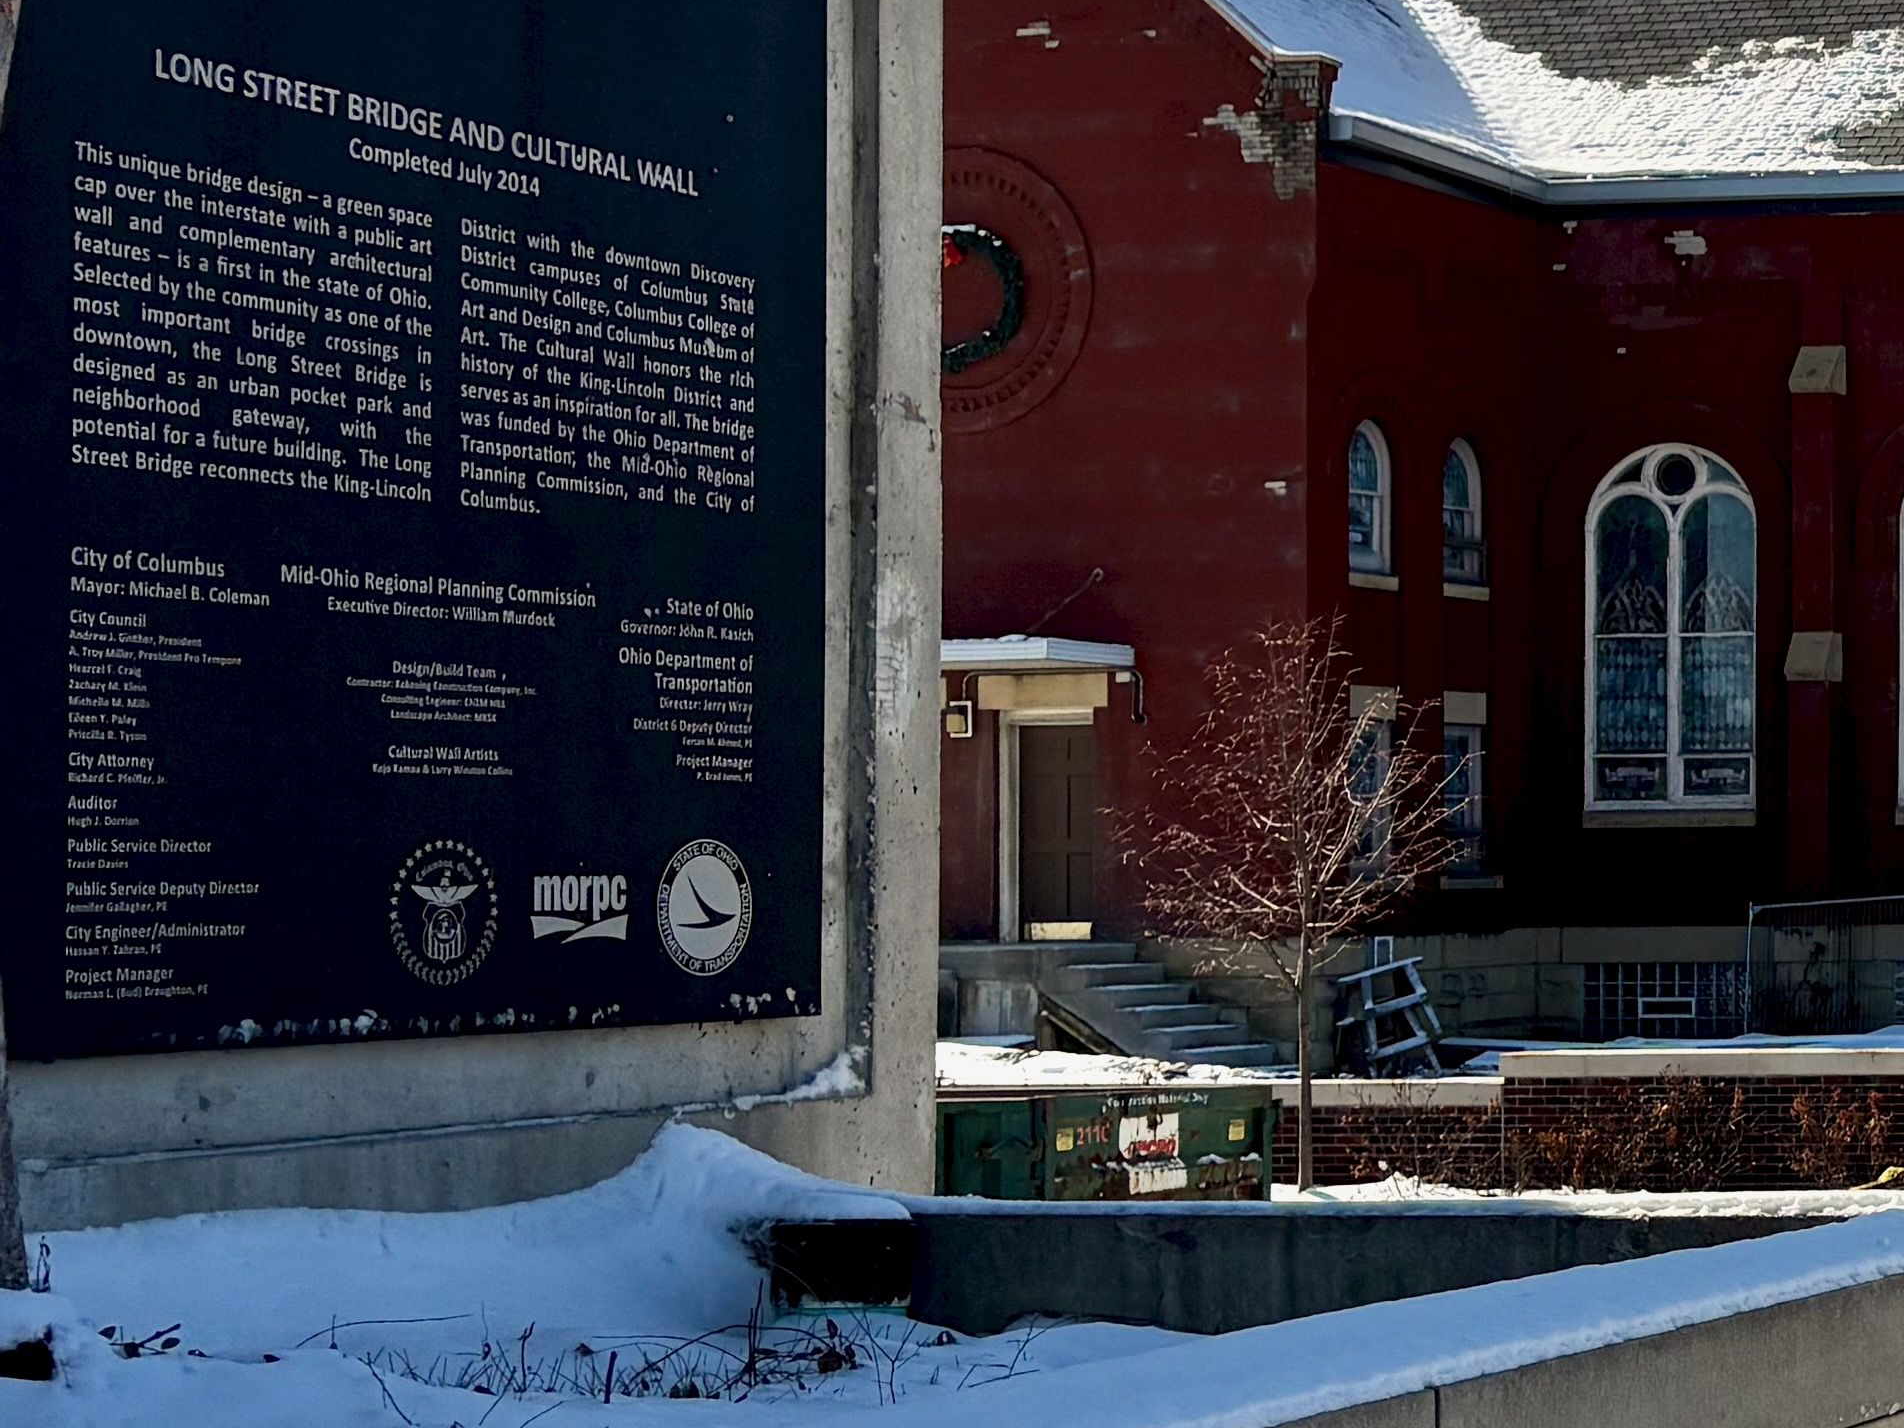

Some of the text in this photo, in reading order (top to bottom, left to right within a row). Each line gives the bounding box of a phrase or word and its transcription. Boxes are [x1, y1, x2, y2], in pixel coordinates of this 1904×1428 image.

[155, 48, 698, 196] LONG STREET BRIDGE AND CULTURAL WALL
[348, 137, 540, 197] Completed July 2014
[73, 205, 432, 282] wall and complementary architectural
[74, 175, 432, 255] cap over the interstate with a public art
[461, 217, 755, 294] District with the downtown Discovery
[73, 262, 432, 337] Selected by the community as one of the
[460, 272, 754, 339] Community College, Columbus College of
[73, 296, 431, 364] most important bridge crossings in
[73, 322, 432, 392] downtown, the Long Street Bridge is
[460, 326, 754, 389] Art. The Cultural Wall honors the rich
[72, 352, 431, 419] designed as an urban pocket park and
[460, 351, 754, 412] history of the King-Lincoln District and
[72, 386, 431, 446] neighborhood gateway, with the
[460, 411, 754, 463] was funded by the Ohio Department of
[71, 443, 431, 502] Street Bridge reconnects the King-Lincoln
[72, 418, 431, 478] potential for a future building. The Long
[460, 461, 754, 513] Planning Commission, and the City of
[460, 488, 540, 513] Columbus.
[70, 576, 269, 606] Mayor: Michael B. Coleman
[71, 546, 224, 577] City of Columbus
[280, 564, 596, 607] Mid-Ohio Regional Planning Commission
[69, 608, 146, 627] City Council
[666, 597, 753, 620] State of Ohio
[618, 646, 753, 672] Ohio Department of
[654, 672, 752, 694] Transportation
[672, 843, 701, 872] STATE
[533, 874, 628, 922] morpc
